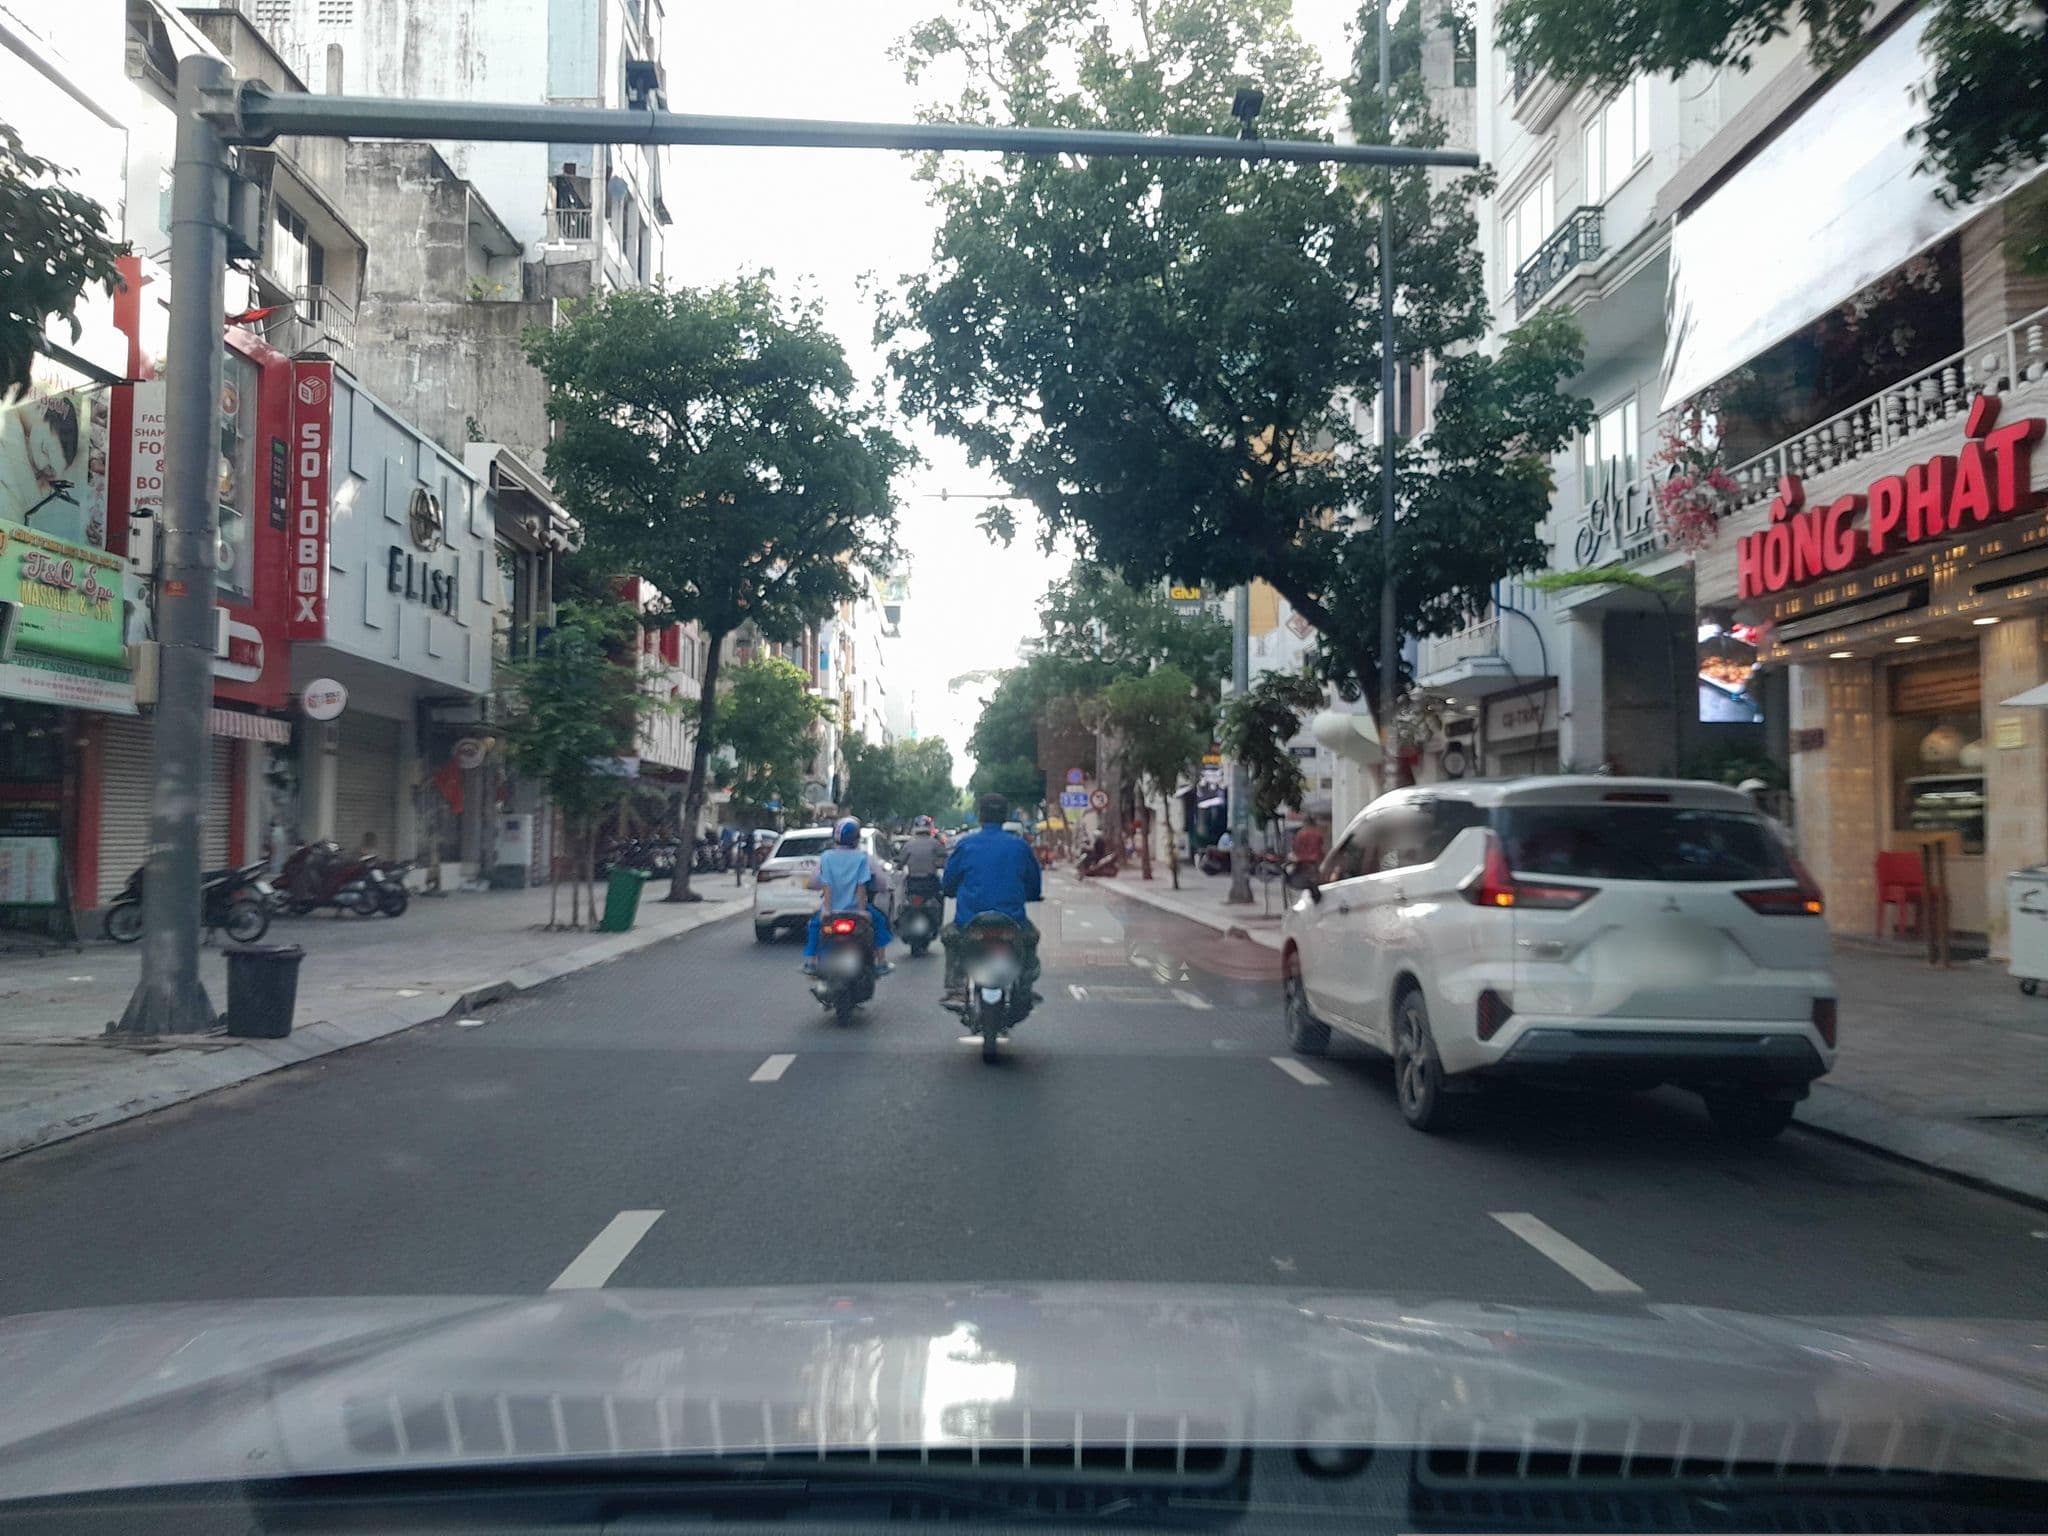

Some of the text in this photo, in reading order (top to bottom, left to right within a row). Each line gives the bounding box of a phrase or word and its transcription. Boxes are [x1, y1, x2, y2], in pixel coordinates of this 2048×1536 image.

[142, 414, 164, 424] FAC
[138, 441, 165, 455] FO
[1737, 393, 2042, 600] HỒNG PHÁT
[295, 422, 322, 622] SOLOBOX
[21, 582, 73, 613] MASSAGE
